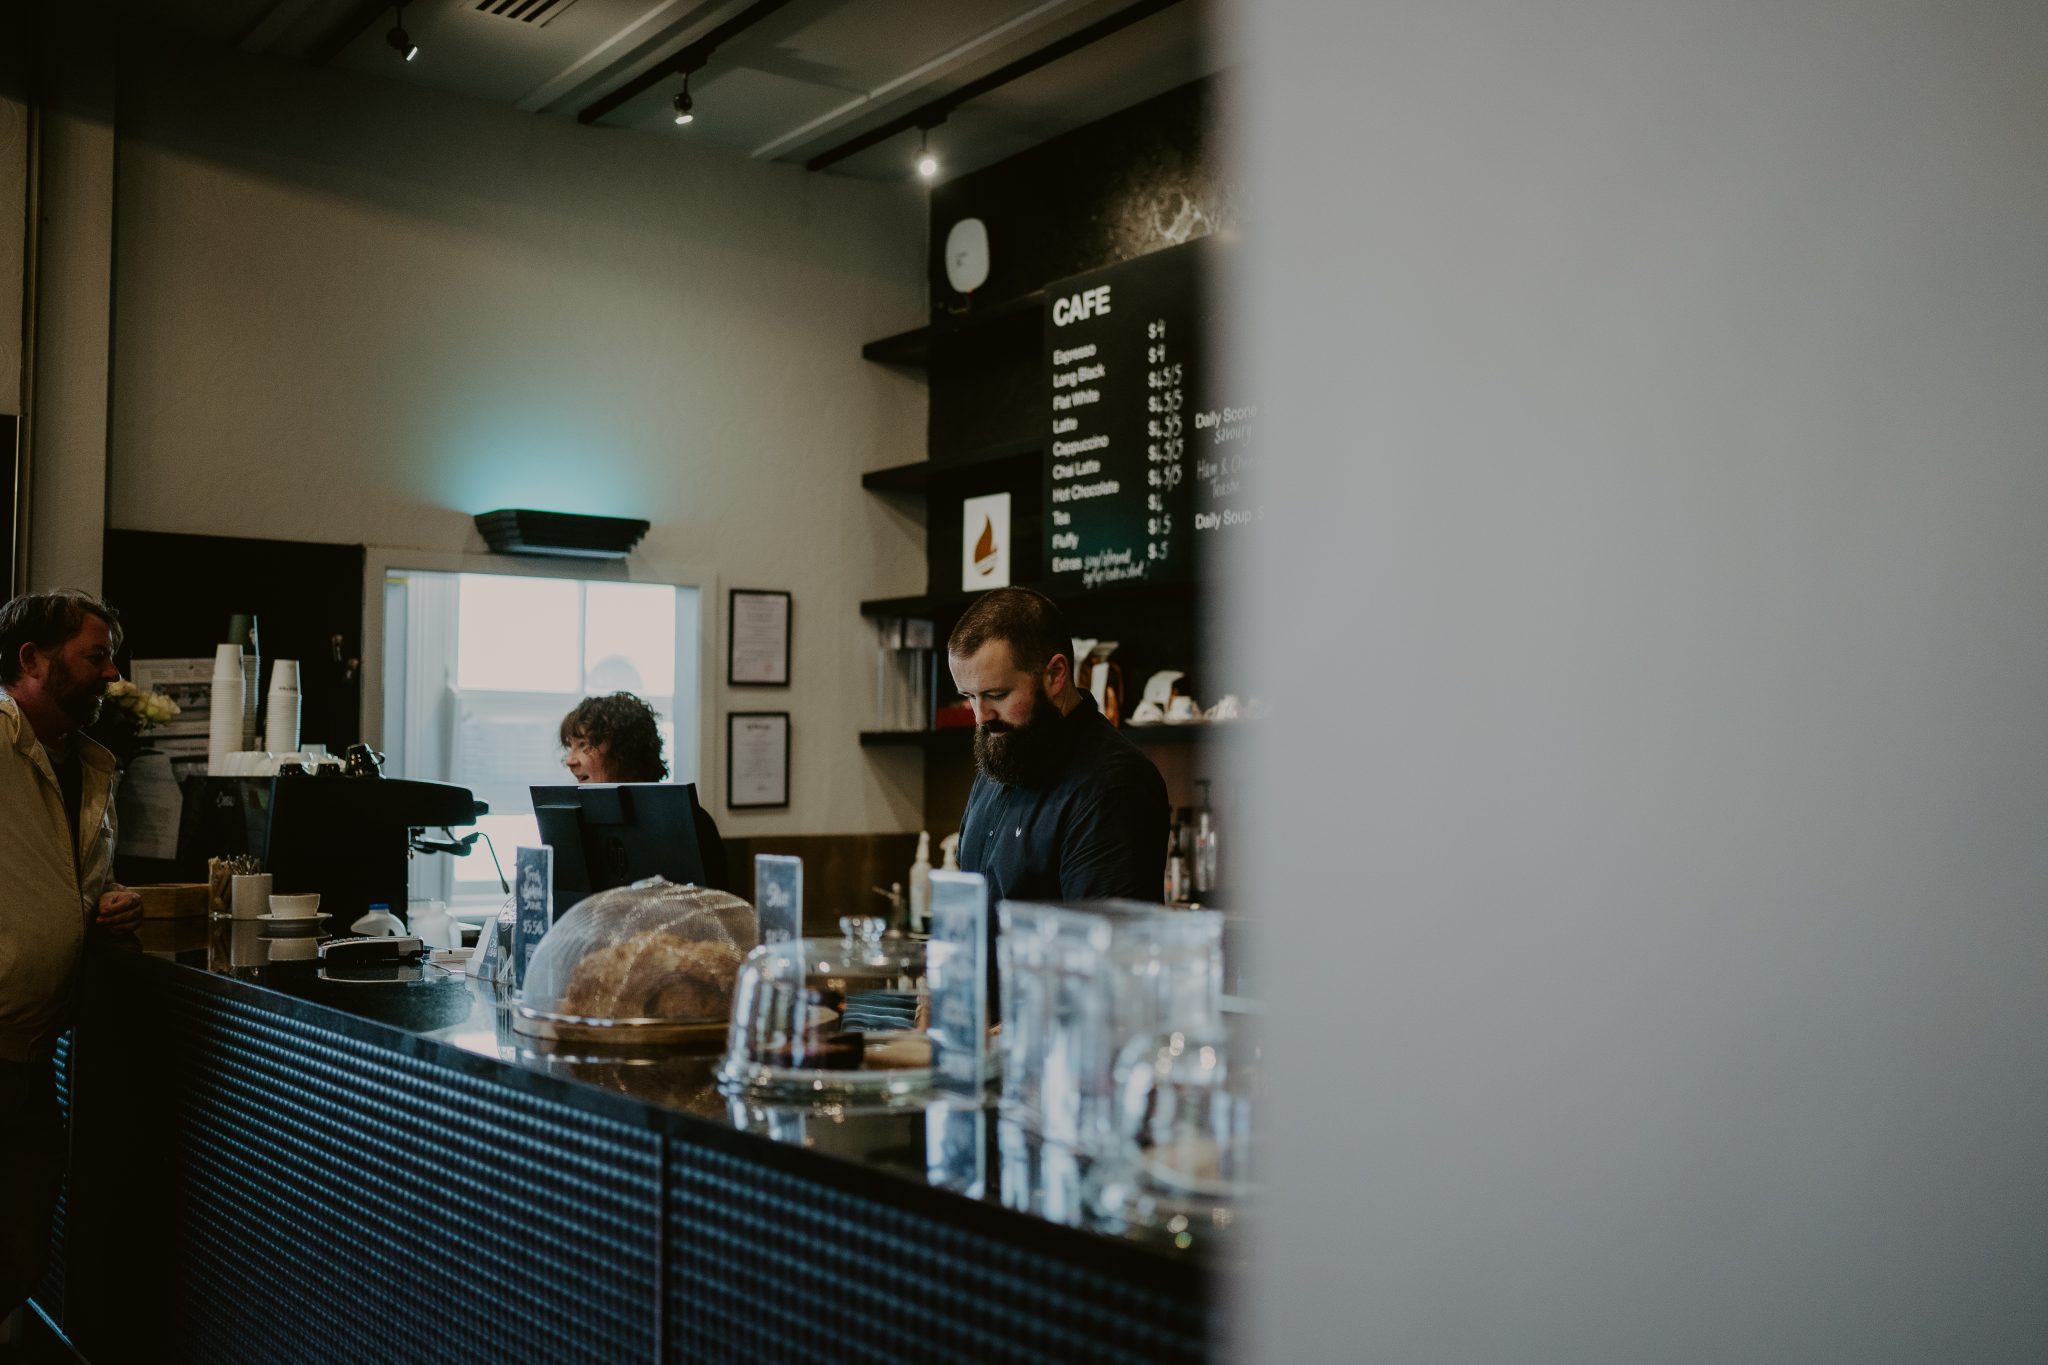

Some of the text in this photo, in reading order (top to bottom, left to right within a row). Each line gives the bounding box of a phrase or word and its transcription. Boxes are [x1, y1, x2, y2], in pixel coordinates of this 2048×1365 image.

[1053, 285, 1111, 327] CAFE
[1053, 362, 1106, 388] Long Black
[1053, 389, 1100, 411] Flat White
[1053, 417, 1079, 434] Latte
[1195, 411, 1221, 429] Daily
[1053, 434, 1110, 457] Cappuccino
[1053, 459, 1101, 480] Chai Latte
[1053, 480, 1120, 503] Hot Chocolate
[1052, 510, 1071, 526] Tea
[1195, 511, 1221, 530] Daily
[1222, 508, 1251, 527] Soup
[1052, 556, 1083, 573] Extras
